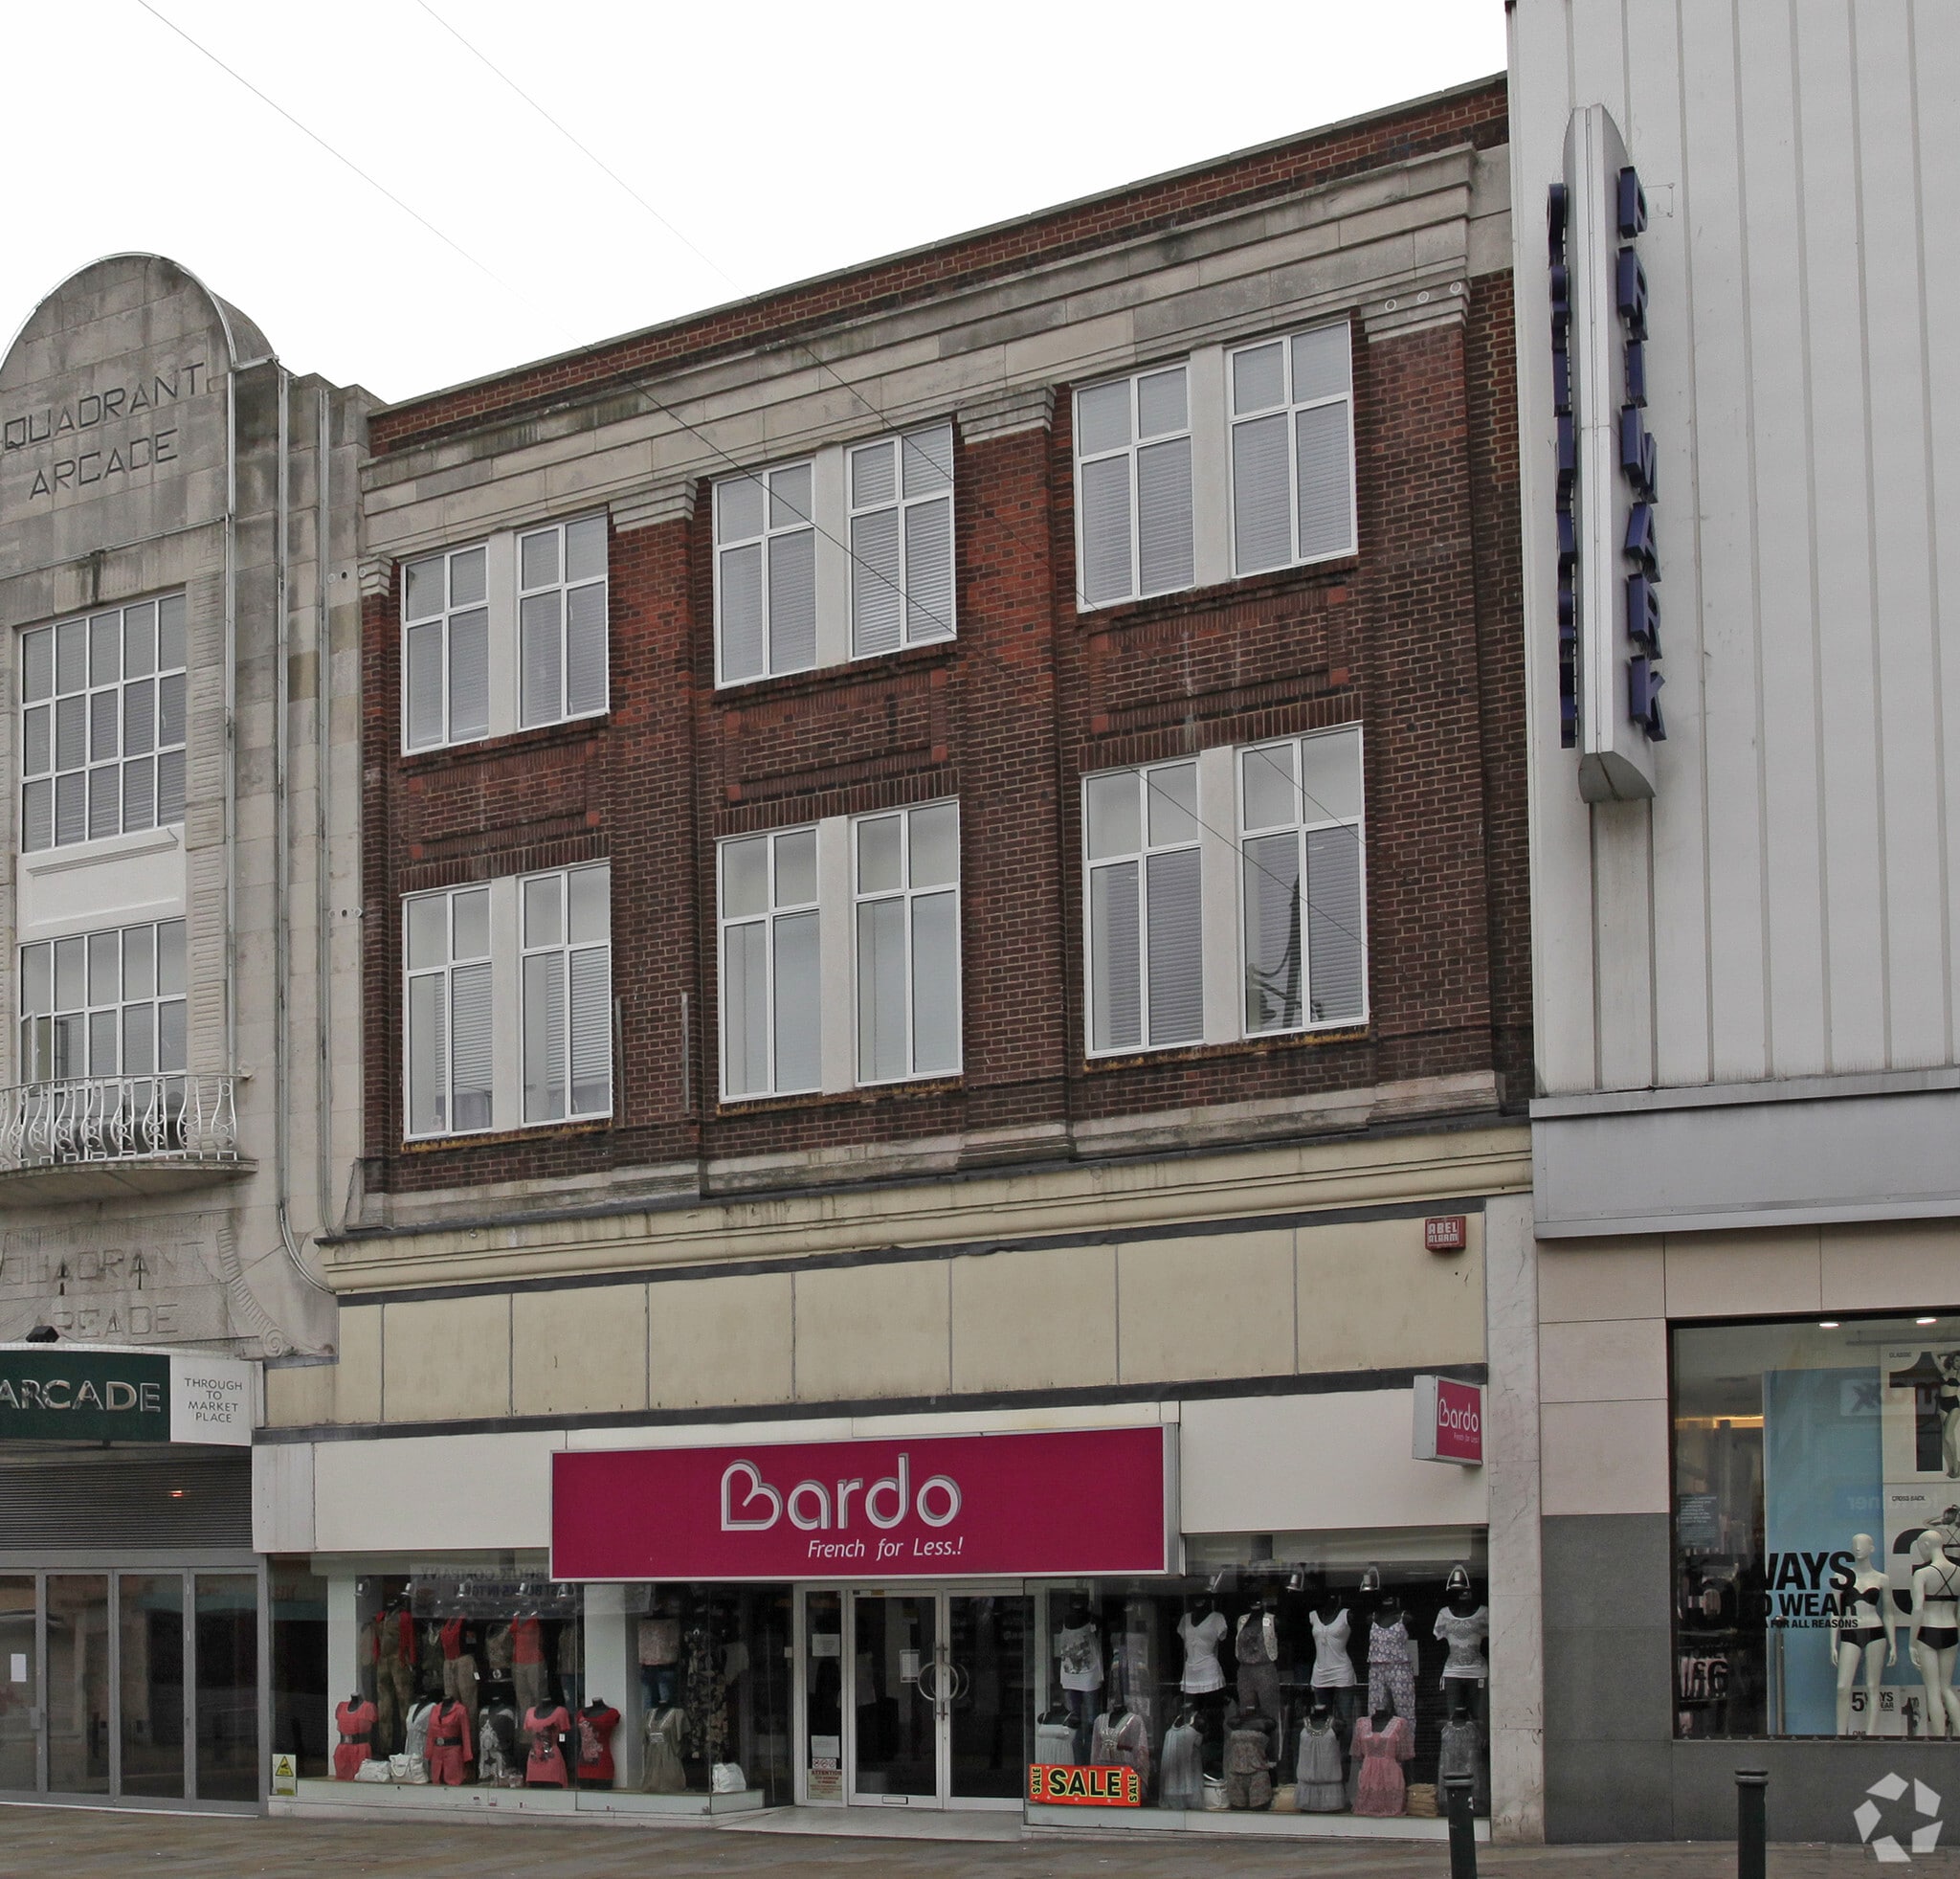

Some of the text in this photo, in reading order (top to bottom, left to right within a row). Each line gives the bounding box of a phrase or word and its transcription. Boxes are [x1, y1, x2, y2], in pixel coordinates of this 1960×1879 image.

[5, 363, 204, 452] QUADRANT
[29, 429, 178, 501] ARCADE
[1617, 167, 1667, 742] PRIMARK
[1428, 1221, 1457, 1234] ABEL
[1429, 1234, 1458, 1242] ALARM
[0, 1379, 161, 1413] ARCADE
[184, 1377, 243, 1391] THROUGH
[206, 1390, 222, 1400] TO
[188, 1400, 238, 1412] MARKET
[195, 1412, 232, 1422] PLACE
[1438, 1398, 1479, 1432] Bardo
[721, 1452, 962, 1532] Bardo
[808, 1536, 964, 1561] French for Less.!
[1778, 1593, 1858, 1616] WEAR
[1792, 1619, 1809, 1628] ALL
[1812, 1619, 1859, 1628] REASONS
[1852, 1691, 1864, 1711] 5
[1032, 1767, 1042, 1795] SALE
[1048, 1768, 1122, 1798] SALE
[1127, 1774, 1139, 1802] SALE
